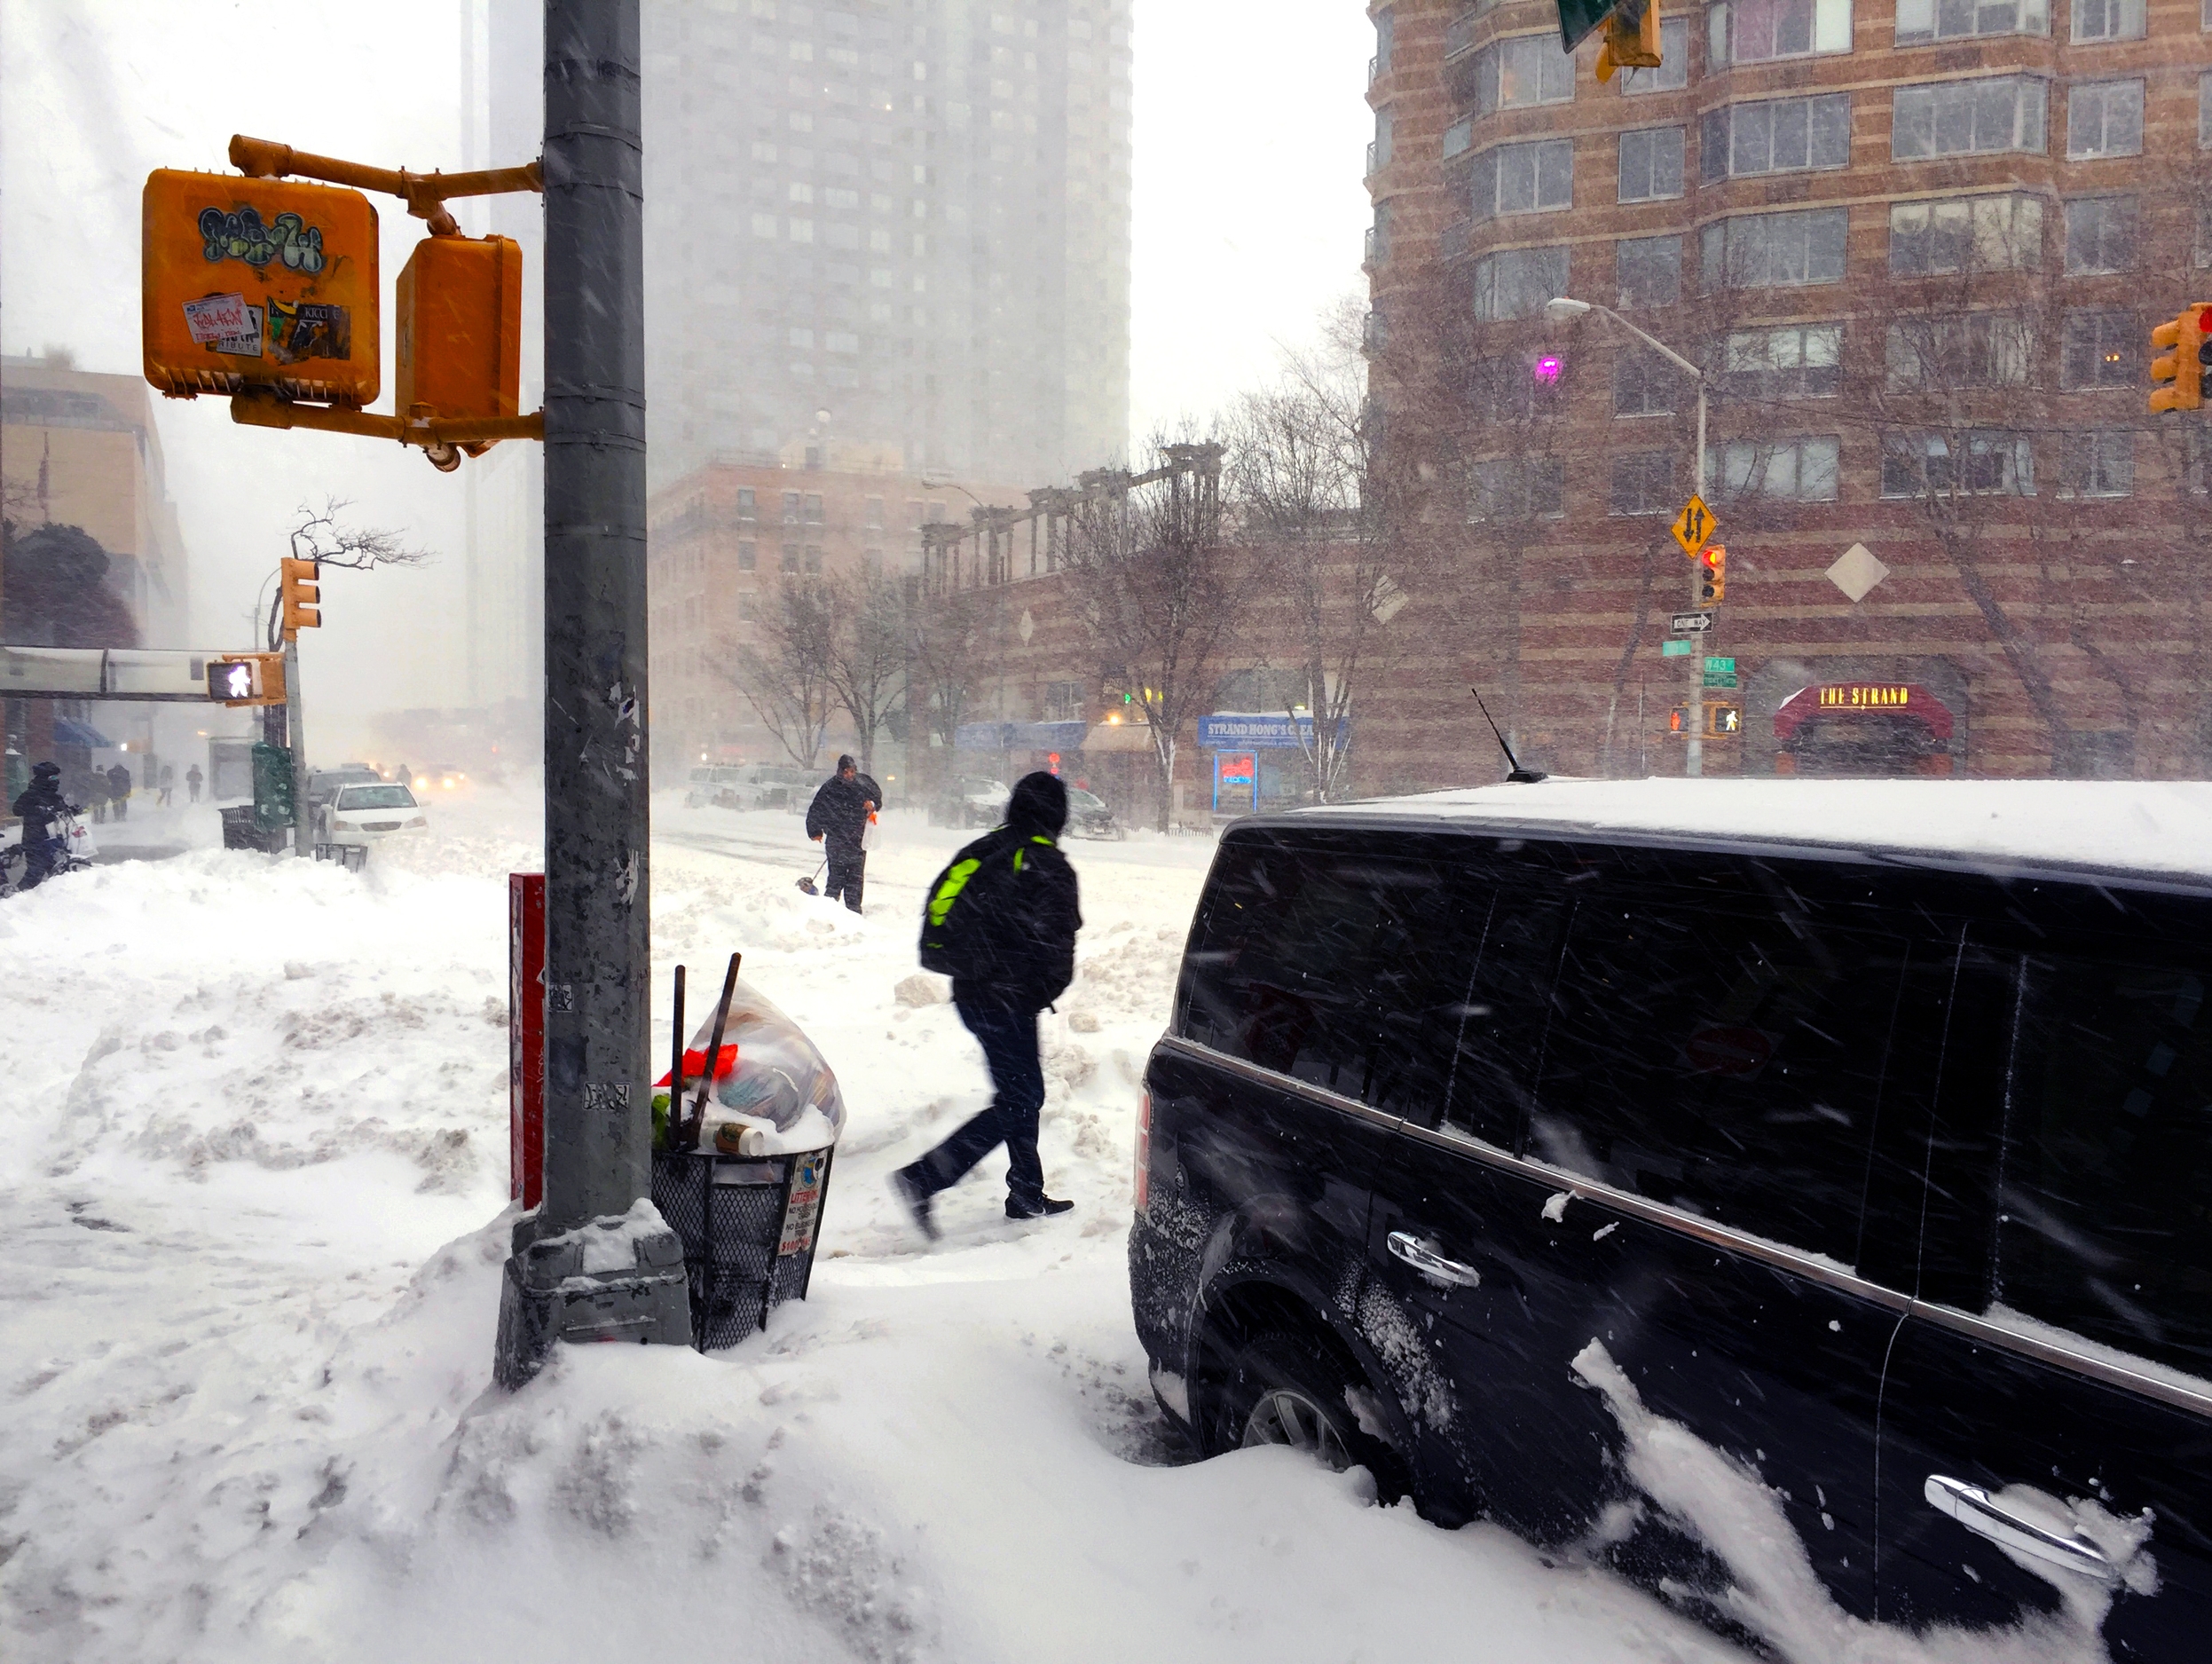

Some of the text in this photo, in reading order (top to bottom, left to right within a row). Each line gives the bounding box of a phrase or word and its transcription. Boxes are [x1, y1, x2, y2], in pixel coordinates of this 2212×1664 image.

[218, 340, 258, 351] RIBUTE
[1820, 687, 1908, 705] THE STRAND
[1208, 723, 1248, 736] STRAND
[1249, 724, 1286, 737] HONG'S
